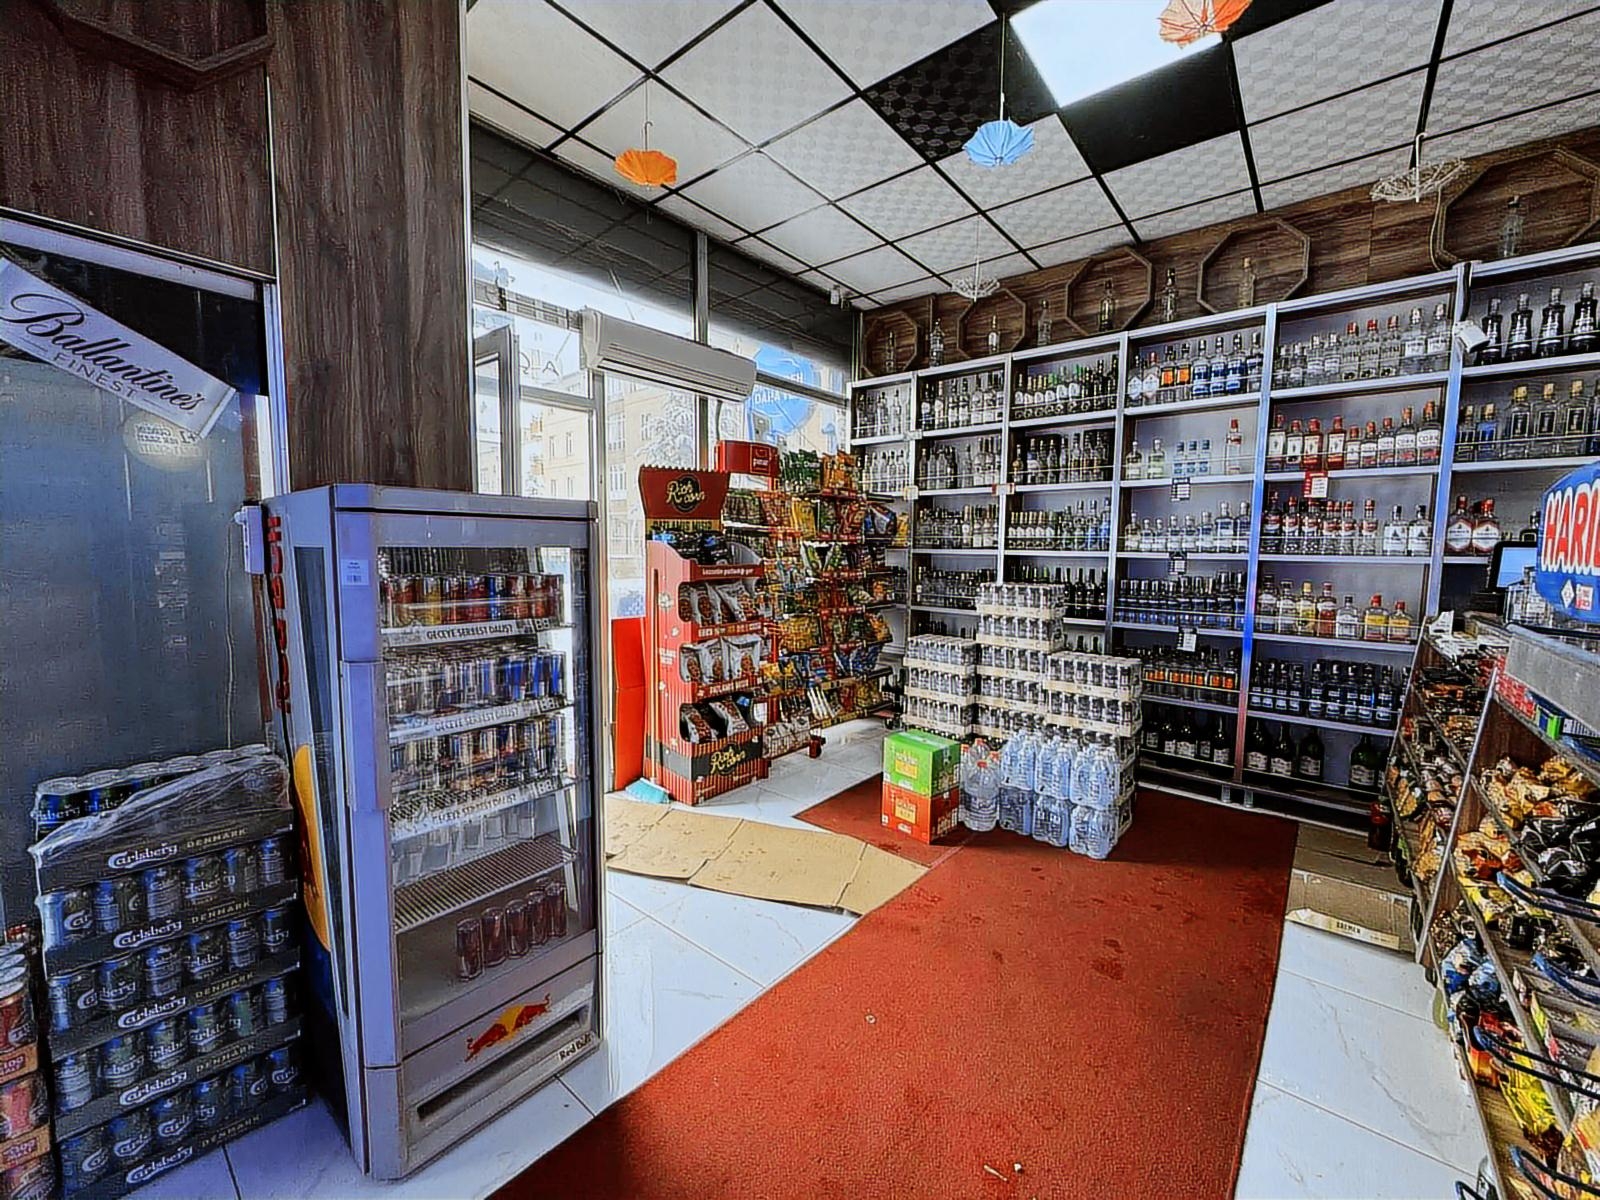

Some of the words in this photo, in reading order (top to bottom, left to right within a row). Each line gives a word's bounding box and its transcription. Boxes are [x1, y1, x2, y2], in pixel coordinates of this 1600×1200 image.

[0, 294, 204, 411] Ballantine's
[53, 353, 137, 398] FINEST
[108, 842, 178, 869] Carlsberg
[187, 828, 247, 849] DENMARK
[113, 918, 183, 948] Carlsberg
[191, 901, 250, 924] DENMARK
[118, 995, 186, 1028] Carlsberg
[195, 971, 254, 998] DENMARK
[559, 1043, 575, 1061] Red
[119, 1070, 187, 1105] Carlsberg
[126, 1146, 193, 1184] Carlsberg
